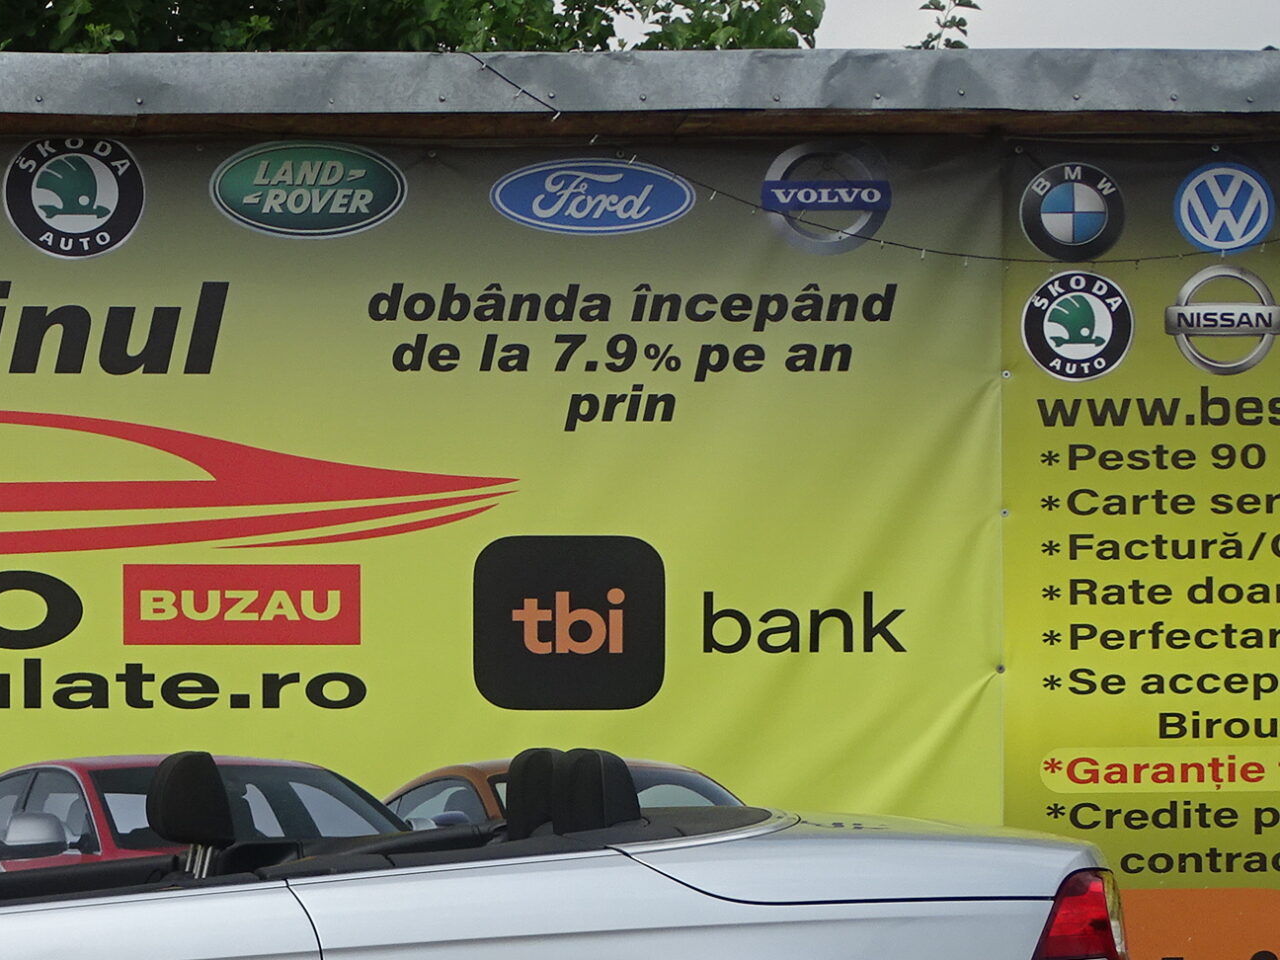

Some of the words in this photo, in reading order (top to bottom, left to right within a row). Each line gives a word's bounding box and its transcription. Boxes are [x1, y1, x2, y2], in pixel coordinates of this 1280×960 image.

[250, 157, 347, 191] LAND
[260, 185, 376, 218] ROVER
[530, 166, 654, 226] Ford
[770, 187, 884, 207] VOLVO
[39, 231, 111, 251] AUTO
[368, 283, 611, 322] dobânda
[631, 283, 897, 332] începând
[1176, 312, 1274, 329] NISSAN
[393, 334, 460, 372] de
[480, 334, 529, 372] la
[555, 334, 681, 372] 7.9%
[694, 344, 765, 382] pe
[785, 344, 852, 372] an
[1050, 357, 1106, 375] AUTO
[565, 384, 675, 431] prin
[1211, 444, 1265, 469] 90
[138, 588, 344, 624] BUZAU
[1188, 576, 1280, 604] doa
[512, 588, 625, 654] tbi
[703, 591, 906, 653] bank
[1141, 673, 1278, 700] accep
[1159, 711, 1277, 738] Birou
